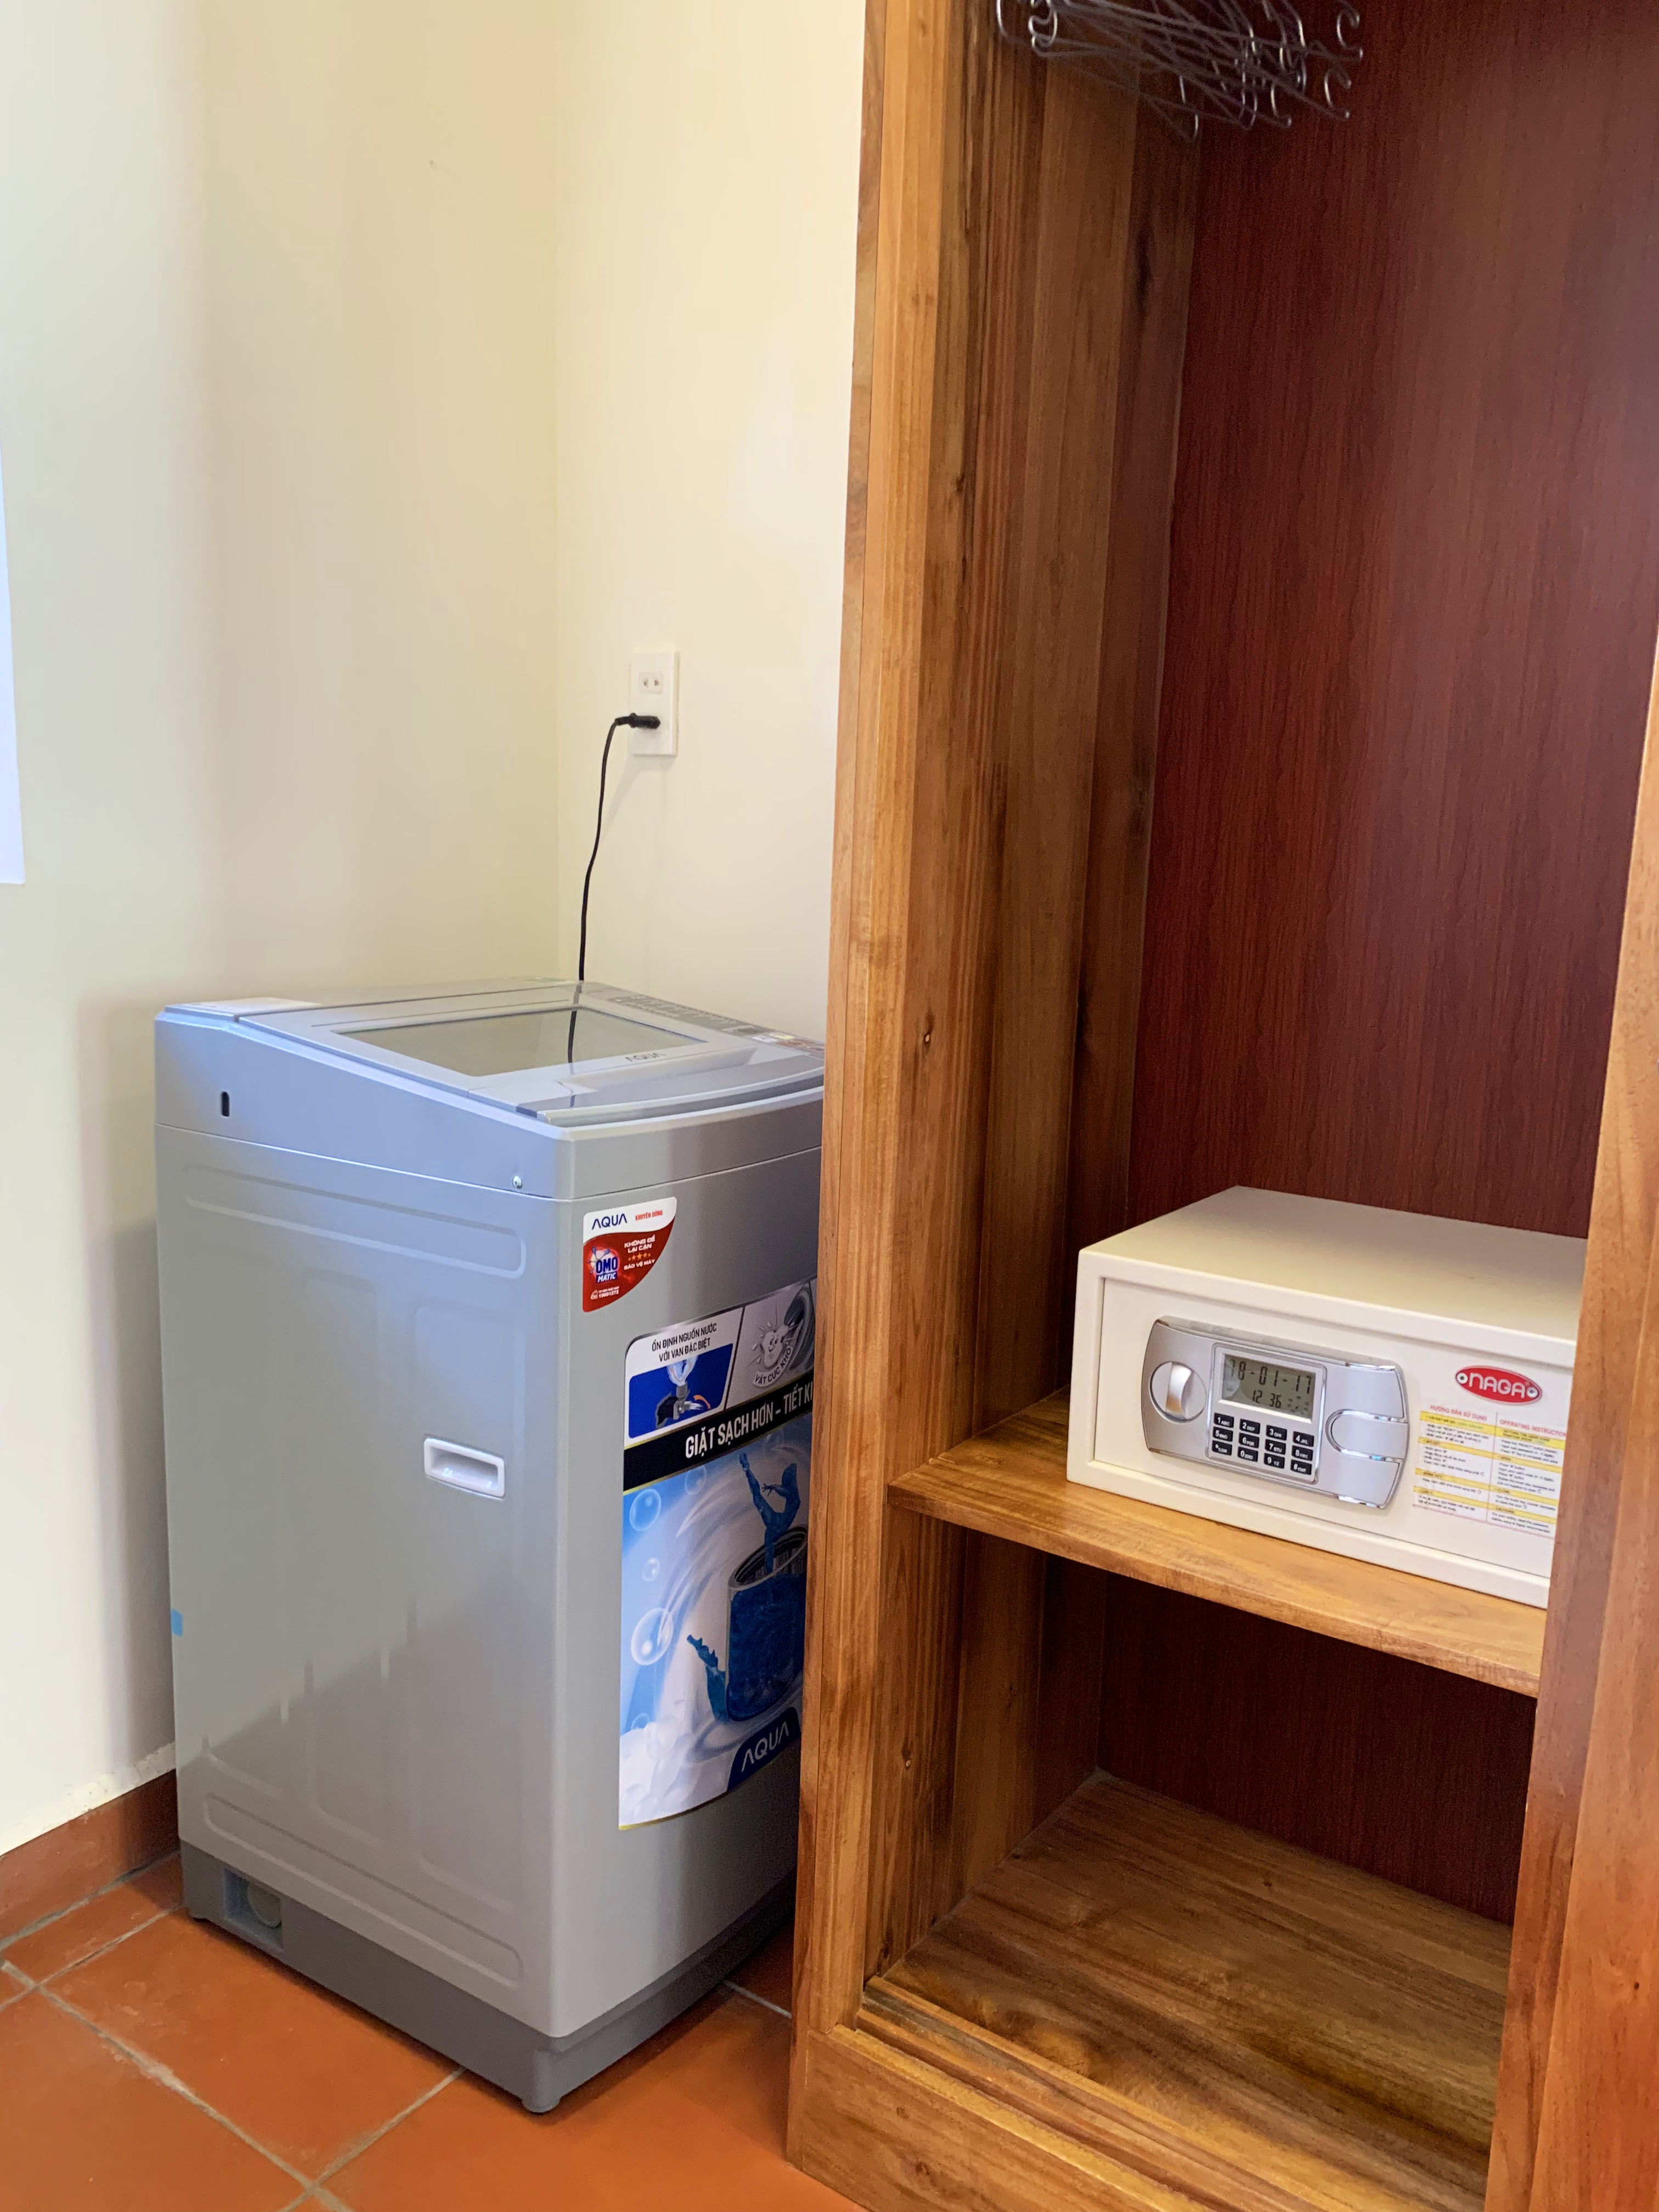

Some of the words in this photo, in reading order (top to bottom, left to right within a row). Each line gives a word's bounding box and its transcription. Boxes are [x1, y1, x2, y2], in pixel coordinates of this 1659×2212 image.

[591, 1214, 627, 1230] AQUA
[596, 1256, 618, 1274] OMO
[597, 1272, 616, 1283] MATIC
[659, 1350, 669, 1362] VỚI
[672, 1347, 684, 1358] VAN
[698, 1337, 710, 1350] BIỆT
[663, 1335, 678, 1348] ĐỊNH
[1469, 1373, 1525, 1398] NAGA
[685, 1427, 715, 1459] GIẶT
[718, 1413, 749, 1446] SẠCH
[751, 1401, 773, 1431] HƠN
[783, 1384, 803, 1415] TIẾT
[741, 1721, 789, 1773] AQUA
